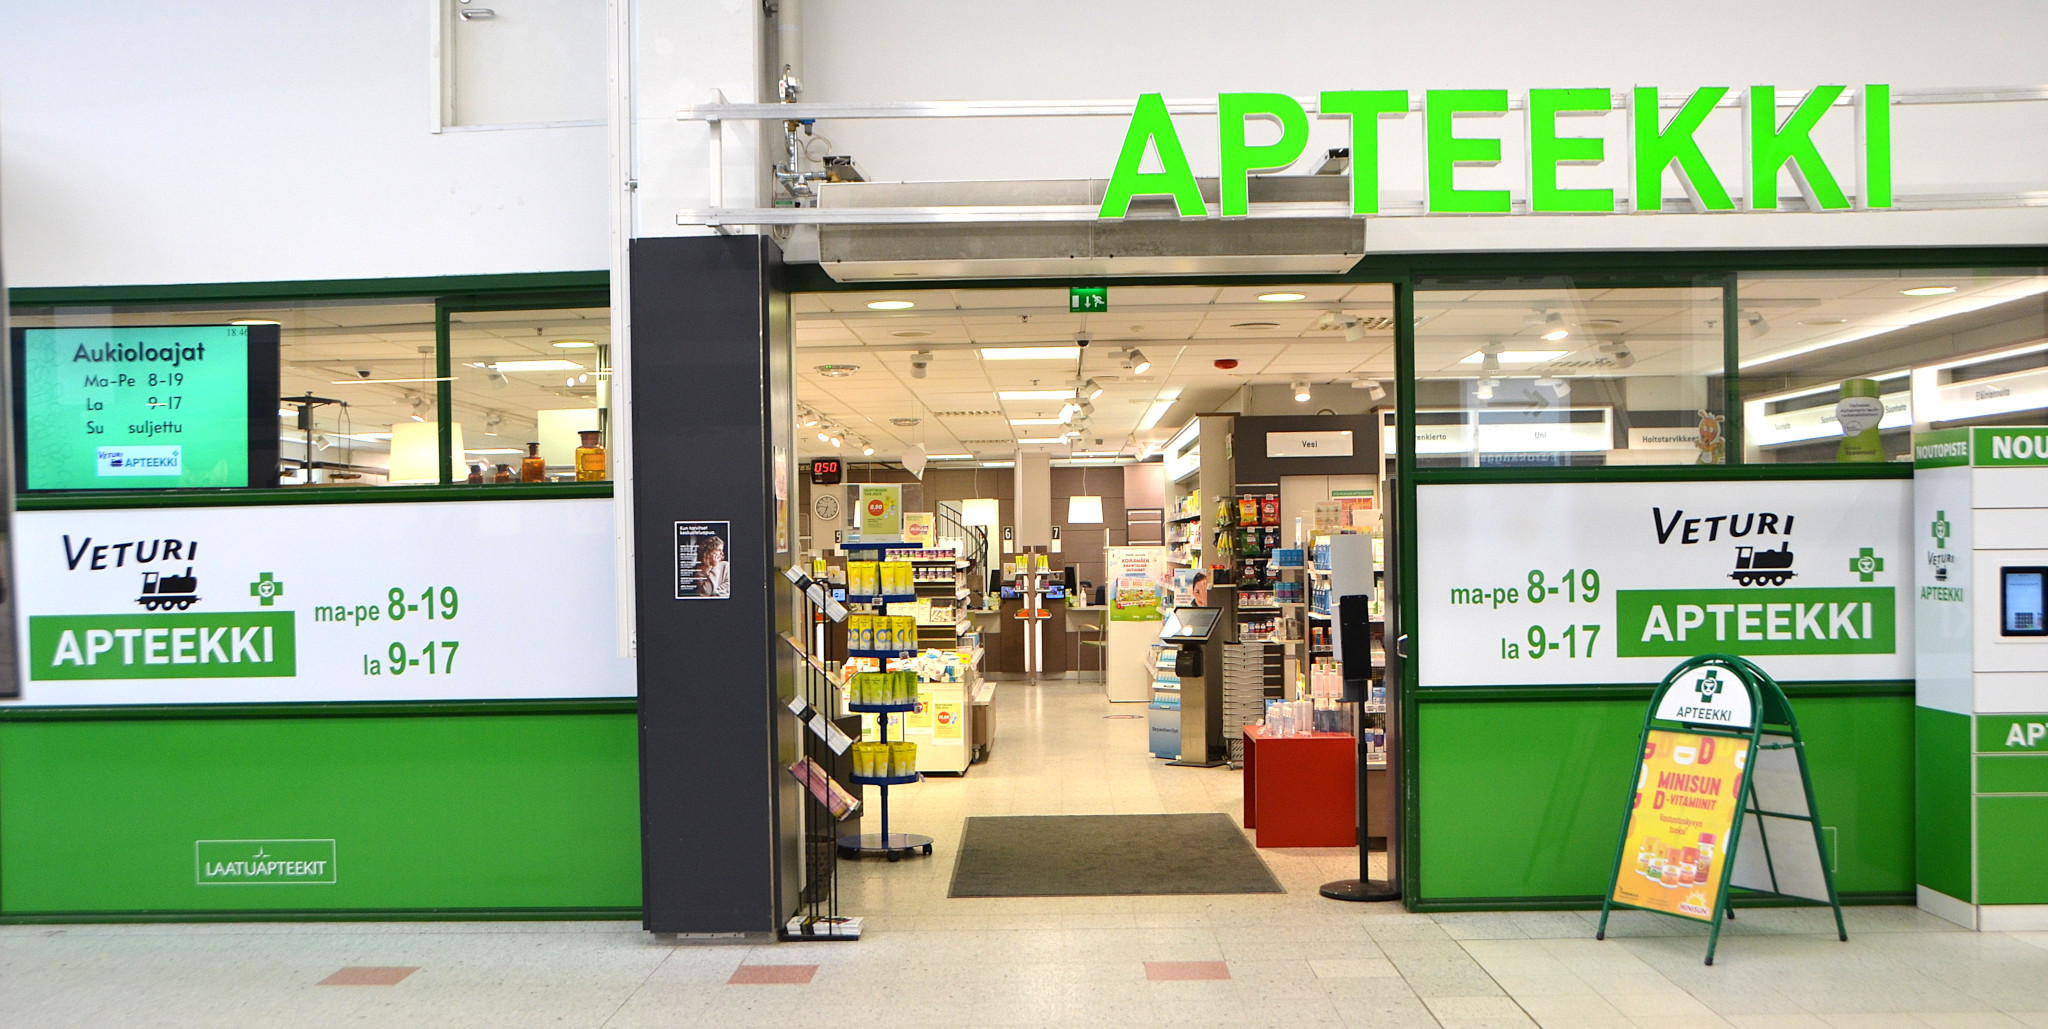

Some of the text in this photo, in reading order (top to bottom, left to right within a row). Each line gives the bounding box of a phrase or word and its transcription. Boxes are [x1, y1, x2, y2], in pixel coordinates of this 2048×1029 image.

[1098, 84, 1892, 219] APTEEKKI
[72, 341, 206, 367] Aukioloajat
[84, 372, 184, 388] Ma-Pe 8-19
[87, 396, 183, 411] La 9-17
[86, 420, 183, 437] Su suljettu
[1534, 431, 1547, 439] Uni
[1302, 440, 1318, 448] Vesi
[1916, 441, 1968, 460] NOUTOPISTE
[1992, 435, 2048, 459] NOU
[125, 457, 178, 468] APTEEKKI
[814, 462, 838, 473] 050
[1005, 528, 1011, 539] 6
[1053, 527, 1059, 538] 7
[1652, 506, 1796, 545] VETURI
[61, 533, 199, 572] VETURI
[1927, 551, 1955, 566] VETURI
[1450, 569, 1602, 609] ma-pe 8-19
[1921, 586, 1964, 602] APTEEKKI
[314, 586, 460, 627] ma-pe 8-19
[1641, 602, 1873, 642] APTEEKKI
[52, 625, 275, 668] APTEEKKI
[1501, 624, 1602, 660] la 9-17
[363, 641, 461, 676] la 9-17
[1676, 705, 1733, 722] APTEEKKI
[2005, 722, 2048, 746] AP
[1657, 770, 1722, 797] MINISUN
[205, 860, 328, 877] LAATUAPTEEKIT
[1679, 902, 1708, 916] MINISUN
